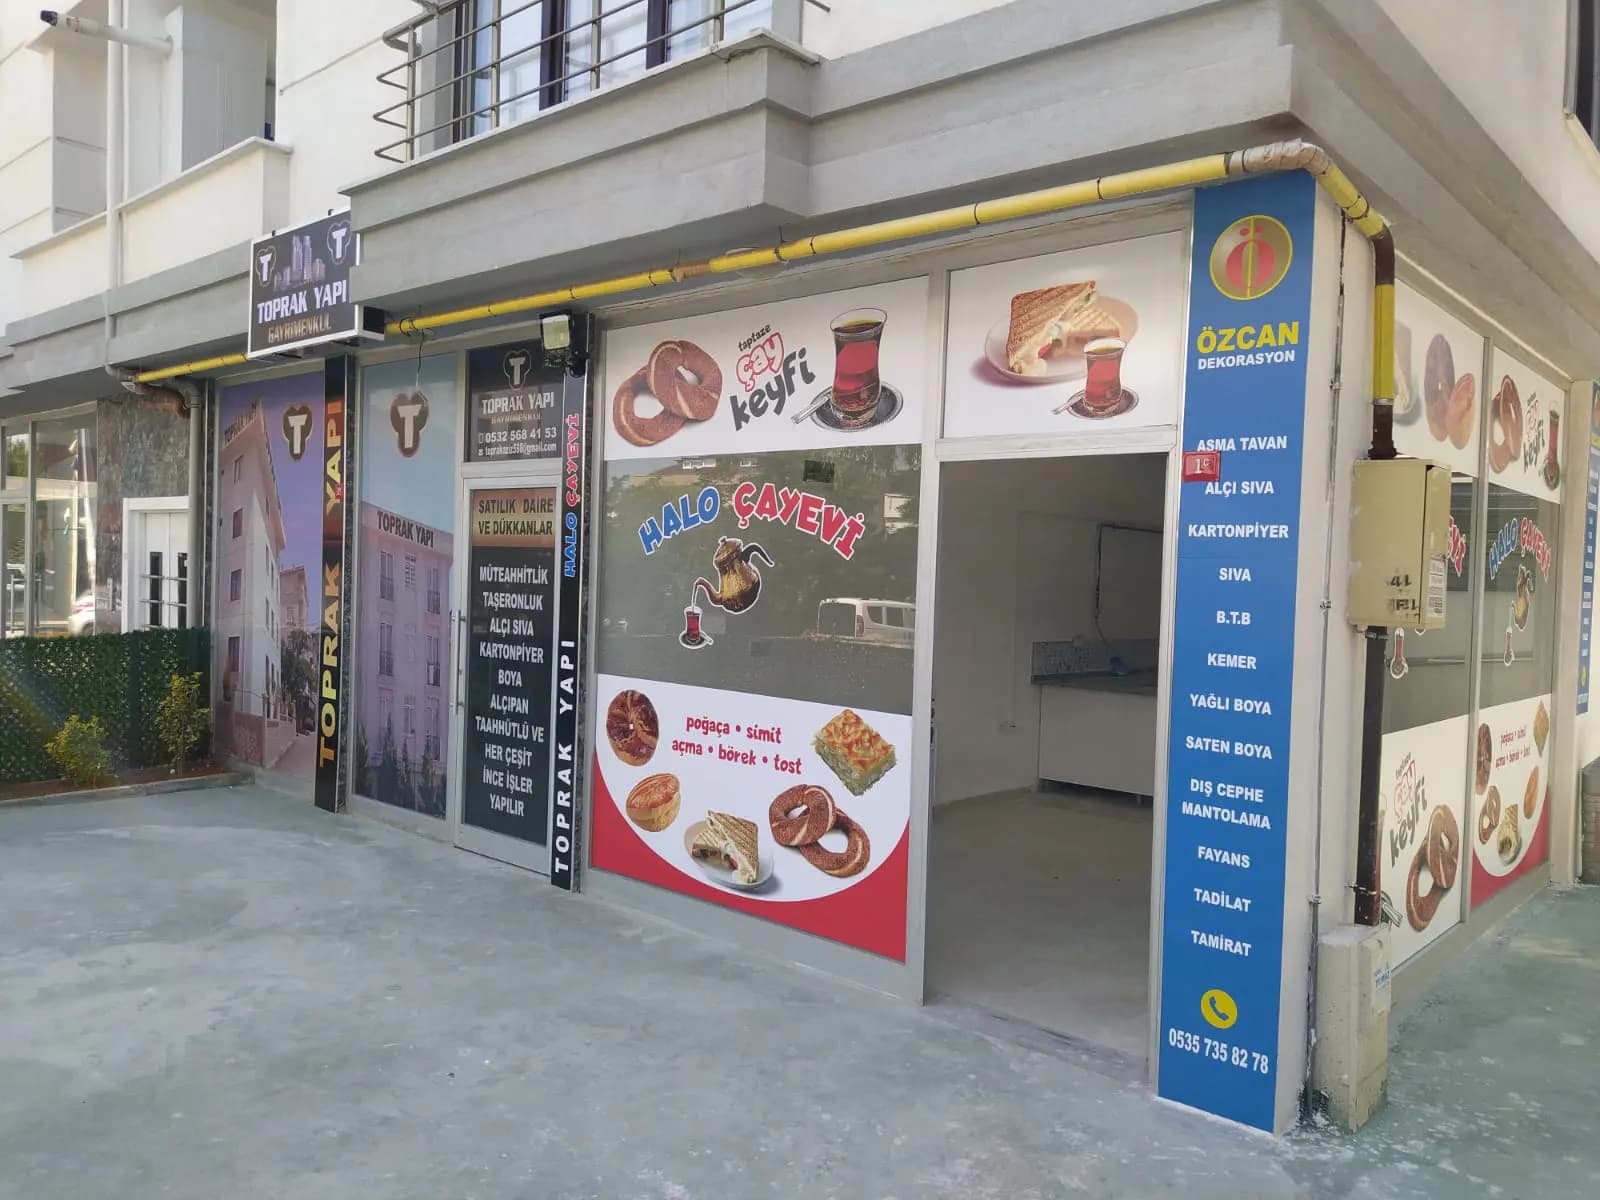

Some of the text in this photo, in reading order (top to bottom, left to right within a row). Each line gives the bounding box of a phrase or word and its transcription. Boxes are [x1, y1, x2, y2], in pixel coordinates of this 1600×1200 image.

[257, 279, 347, 324] TOPRAK YAPI
[738, 324, 771, 352] taptaze
[1197, 321, 1299, 353] ÖZCAN
[736, 332, 784, 392] çay
[1197, 350, 1295, 370] DEKORASYON
[730, 347, 816, 431] keyfi
[482, 392, 555, 415] TOPRAK YAPI
[485, 426, 557, 443] 0532 568 41 53
[1197, 435, 1287, 452] ASMA TAVAN
[564, 413, 581, 578] HALO ÇAYEVİ
[1205, 480, 1274, 498] ALÇI SIVA
[478, 496, 554, 514] SATILIK DAİRE
[377, 511, 434, 548] TOPRAK YAPI
[478, 518, 553, 535] VE DÜKKANLAR
[638, 482, 866, 560] HALO ÇAYEVİ
[1188, 521, 1289, 539] KARTONPİYER
[1489, 518, 1518, 580] HALO
[319, 401, 342, 768] TOPRAK YAPI
[479, 564, 548, 584] MÜTEAHHİTLİK
[1218, 567, 1252, 582] SIVA
[482, 592, 544, 611] TAŞERONLUK
[489, 617, 534, 638] ALÇI SIVA
[1216, 611, 1252, 625] B.T.B
[479, 641, 544, 664] KARTONPİYER
[1207, 652, 1257, 670] KEMER
[498, 669, 522, 687] BOYA
[490, 693, 529, 715] ALÇIPAN
[1190, 693, 1272, 716] YAĞLI BOYA
[475, 715, 545, 743] TAAHHÜTLÜ VE
[685, 716, 782, 744] poğaça simit
[485, 743, 533, 770] HER ÇEŞİT
[554, 640, 575, 873] TOPRAK YAPI
[671, 739, 802, 775] açma börek tost
[1186, 735, 1273, 760] SATEN BOYA
[482, 764, 533, 795] İNCE İŞLER
[1190, 778, 1264, 803] DIŞ CEPHE
[489, 793, 525, 817] YAPILIR
[1181, 801, 1271, 830] MANTOLAMA
[1390, 774, 1428, 868] keyfi
[1197, 845, 1251, 869] FAYANS
[1193, 887, 1251, 913] TADİLAT
[1190, 929, 1251, 957] TAMİRAT
[1168, 1028, 1269, 1075] 0535 735 82 78
